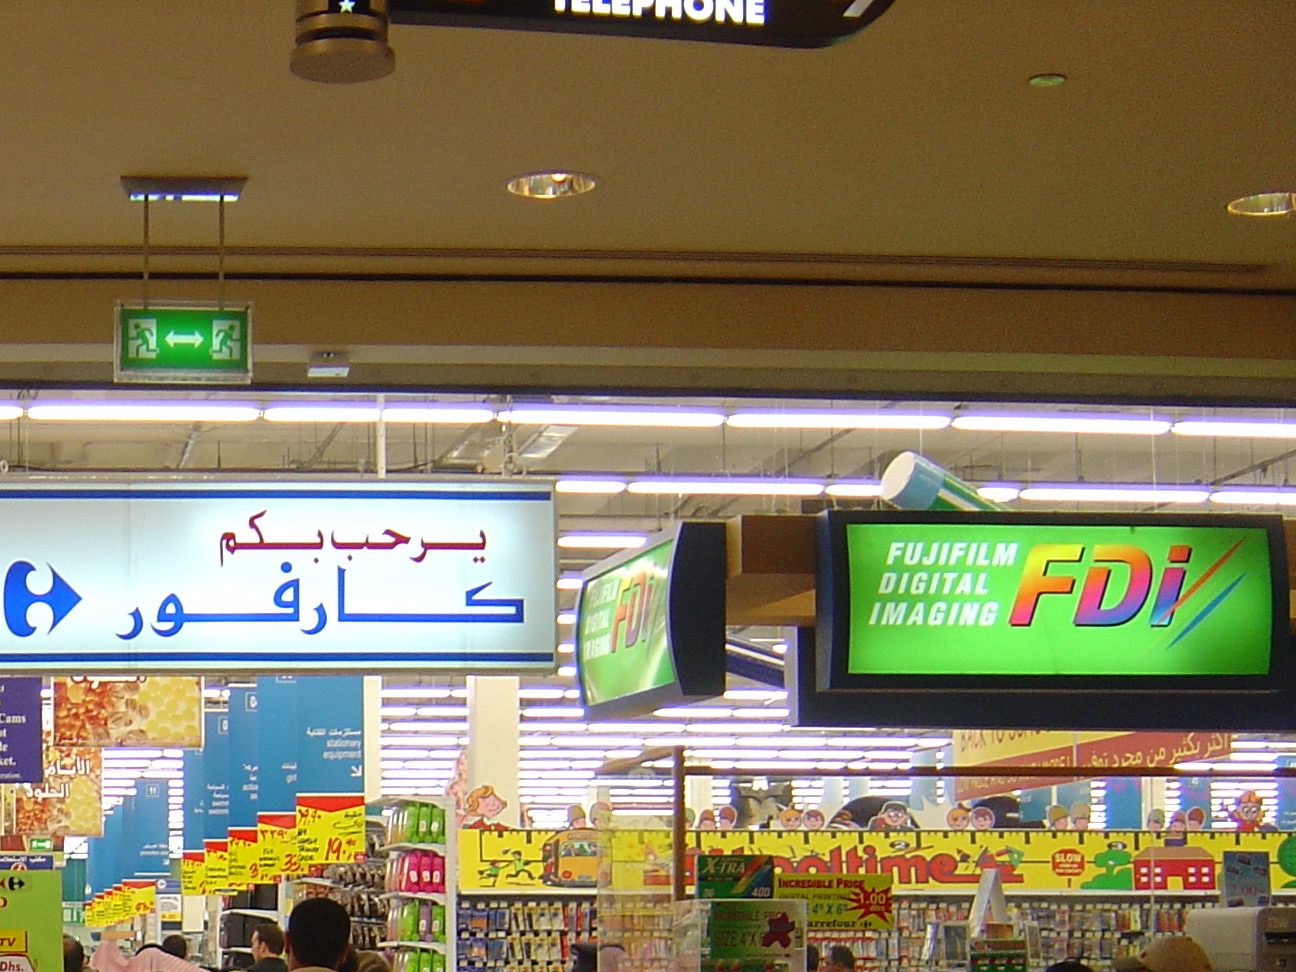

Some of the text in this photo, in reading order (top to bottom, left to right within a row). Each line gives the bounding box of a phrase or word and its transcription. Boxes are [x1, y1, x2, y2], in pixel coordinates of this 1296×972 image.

[220, 510, 486, 568] يرحب بكم
[878, 572, 988, 595] DIGITAL
[886, 542, 1192, 627] FUJIFILM FDi
[115, 562, 524, 640] كارفور
[868, 602, 999, 626] IMAGING
[1055, 853, 1081, 863] SLOW
[702, 857, 746, 874] X-TRA
[778, 878, 865, 889] INCREDIBLE PRICE
[752, 887, 771, 897] 400
[860, 893, 886, 904] 1.00
[807, 920, 857, 928] arrefour
[0, 961, 24, 972] Dhs.
